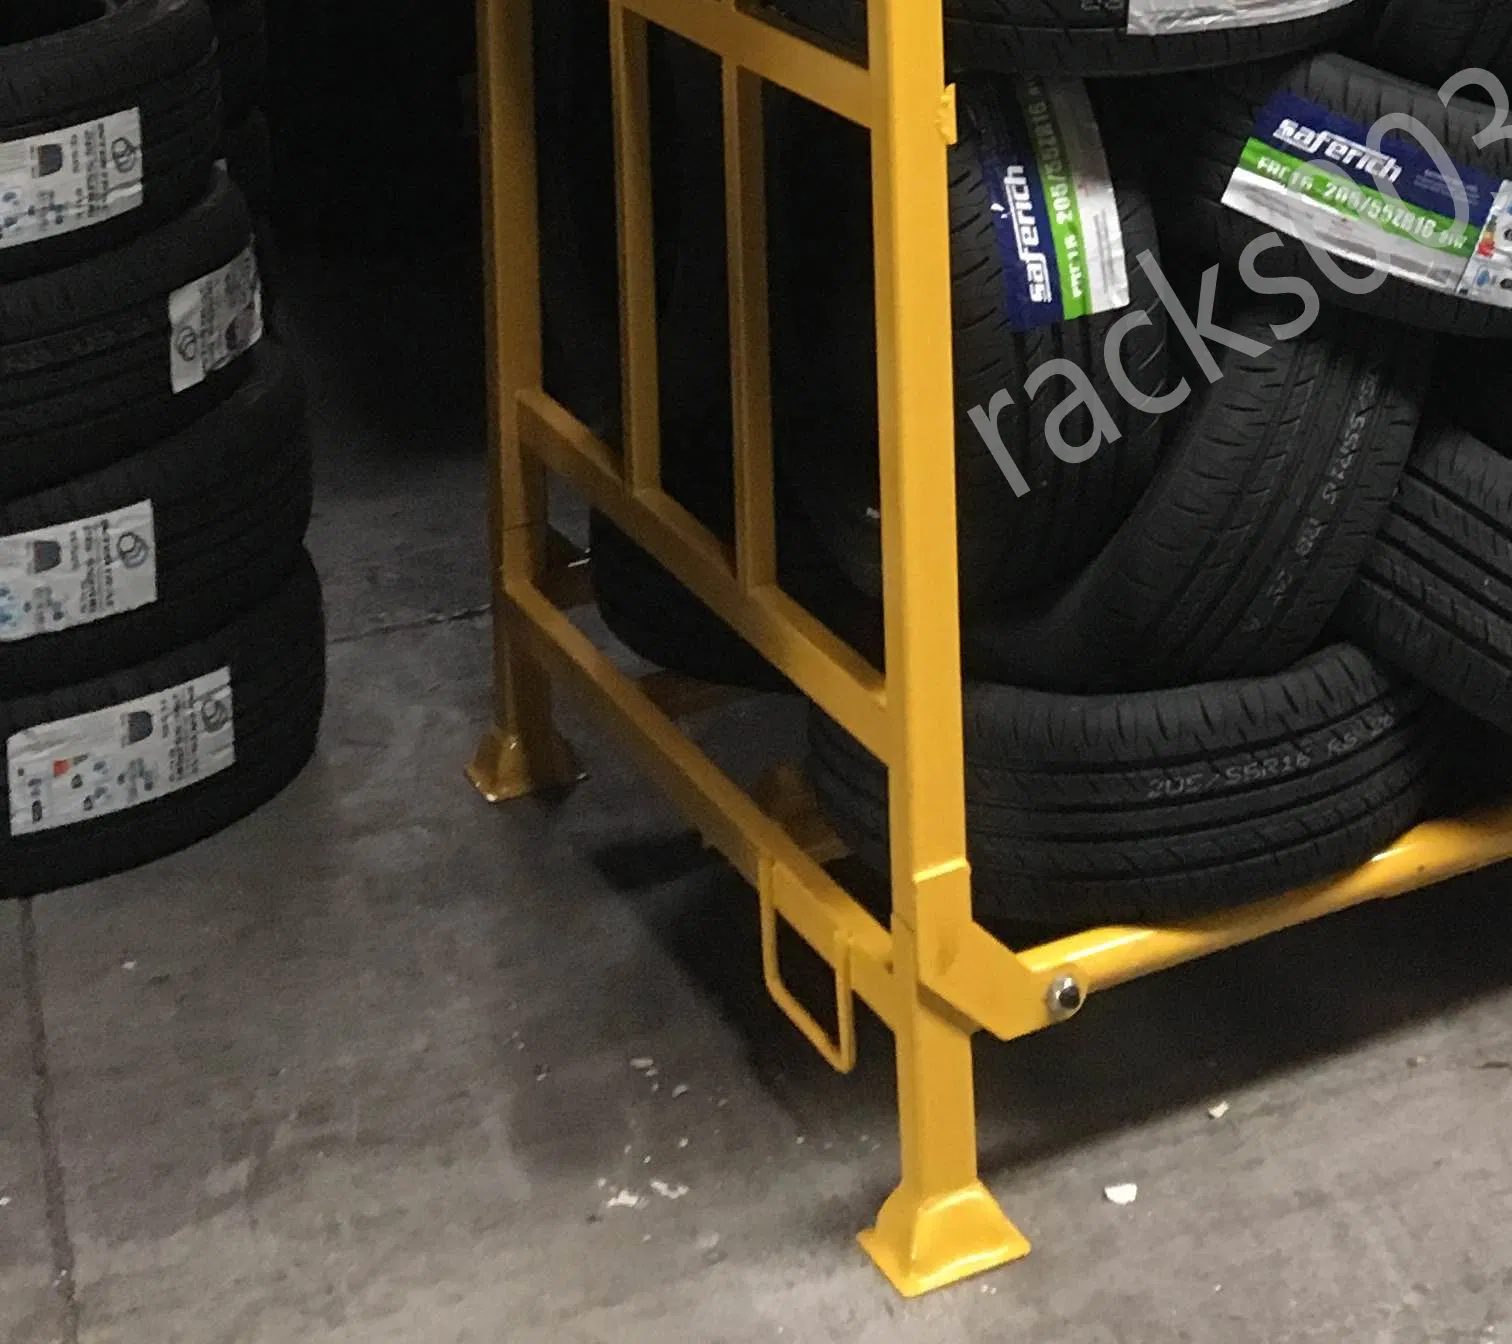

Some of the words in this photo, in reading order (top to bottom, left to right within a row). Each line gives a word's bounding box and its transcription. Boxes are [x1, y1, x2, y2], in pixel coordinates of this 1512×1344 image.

[1270, 115, 1404, 185] saferich
[1003, 164, 1052, 303] saferich
[1255, 155, 1314, 192] FRC16
[1321, 181, 1437, 240] 205/55ZR16
